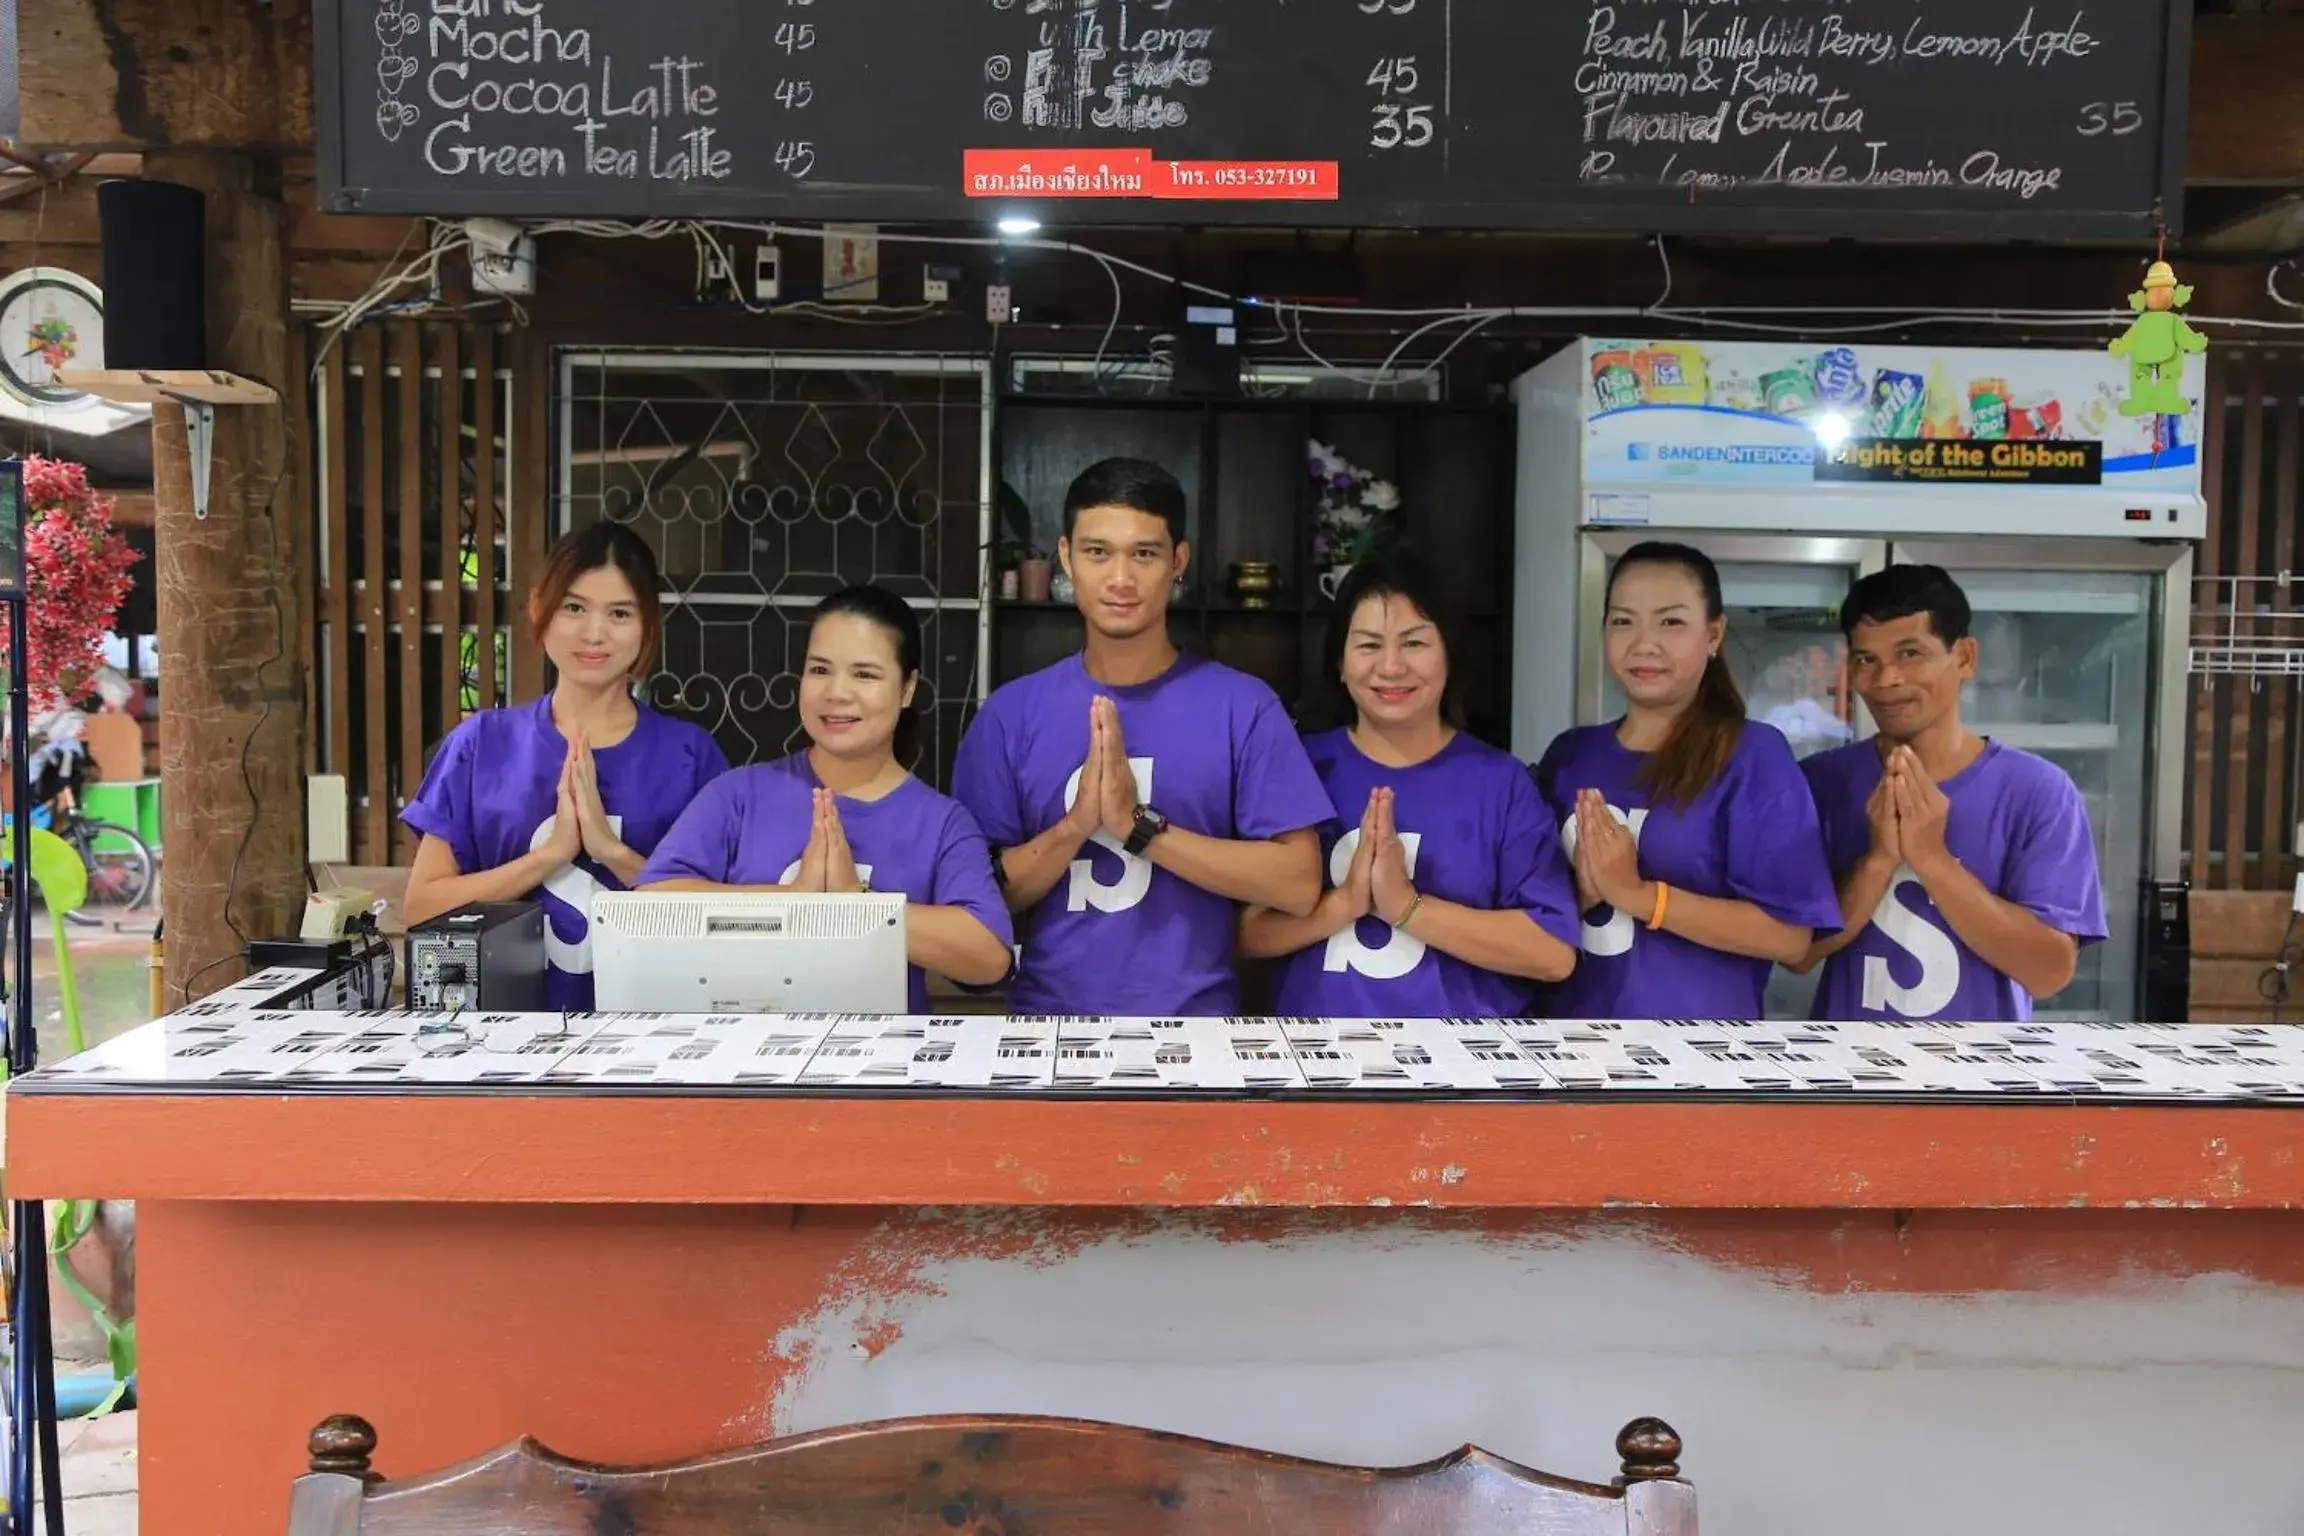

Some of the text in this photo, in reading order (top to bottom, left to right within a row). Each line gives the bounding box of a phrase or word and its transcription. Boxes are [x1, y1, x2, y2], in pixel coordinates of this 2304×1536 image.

[429, 14, 590, 67] Mocha
[775, 23, 815, 55] 45
[428, 55, 719, 119] Cocoa Latte
[775, 78, 813, 109] 45
[1365, 55, 1418, 96] 45
[1574, 57, 1819, 97] Cinnamon & Raisin
[1370, 104, 1434, 148] 35
[2076, 101, 2142, 135] 35
[424, 113, 733, 181] Green tea Latte
[774, 142, 816, 179] 45
[1170, 162, 1317, 186] โทร. 053-327191
[1960, 150, 2062, 199] Orange
[1910, 443, 1936, 467] of
[1941, 444, 1986, 467] the
[1991, 445, 2085, 468] Gibbon
[1861, 858, 1961, 1017] S
